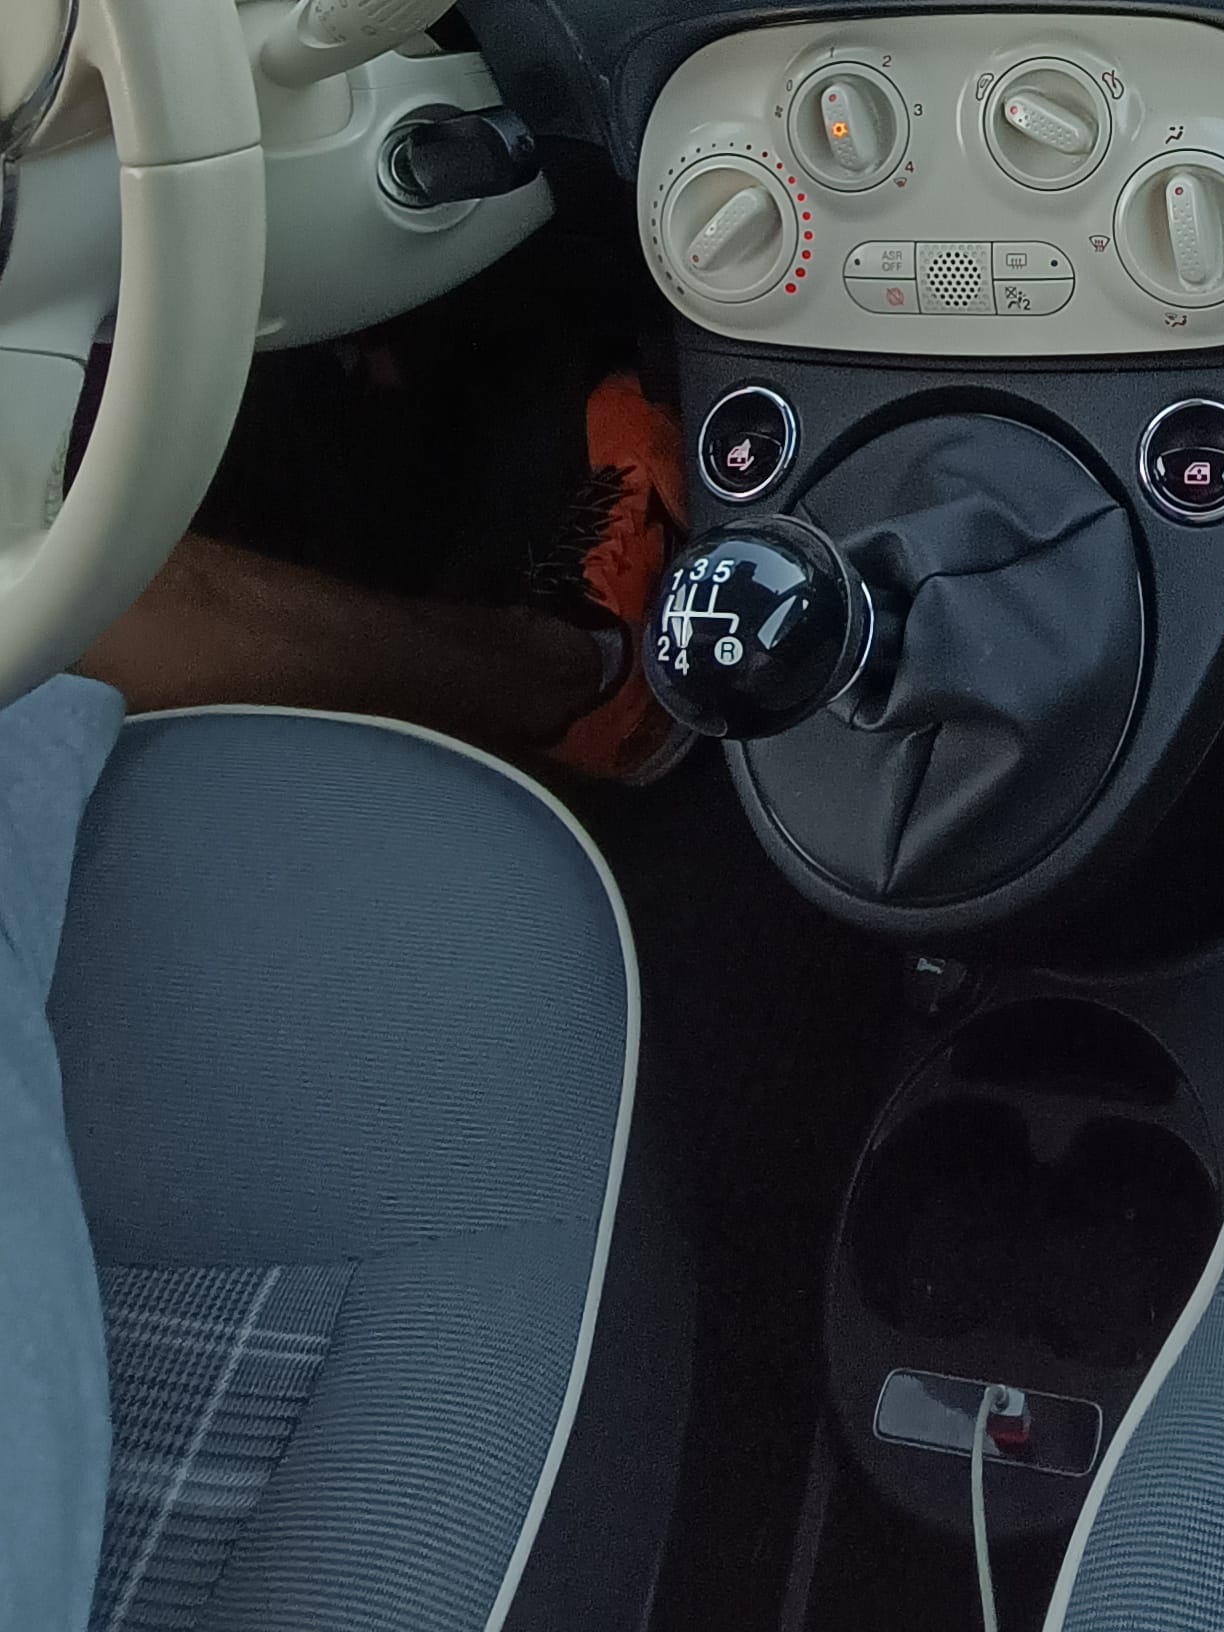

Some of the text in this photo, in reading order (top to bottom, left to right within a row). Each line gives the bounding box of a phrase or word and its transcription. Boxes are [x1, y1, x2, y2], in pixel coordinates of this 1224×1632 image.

[882, 55, 892, 67] 2
[913, 103, 923, 116] 3
[905, 161, 914, 173] 4
[882, 251, 902, 260] ASR
[882, 262, 902, 272] OFF
[671, 558, 735, 591] 1 3 5
[657, 635, 735, 676] 2 4 R
